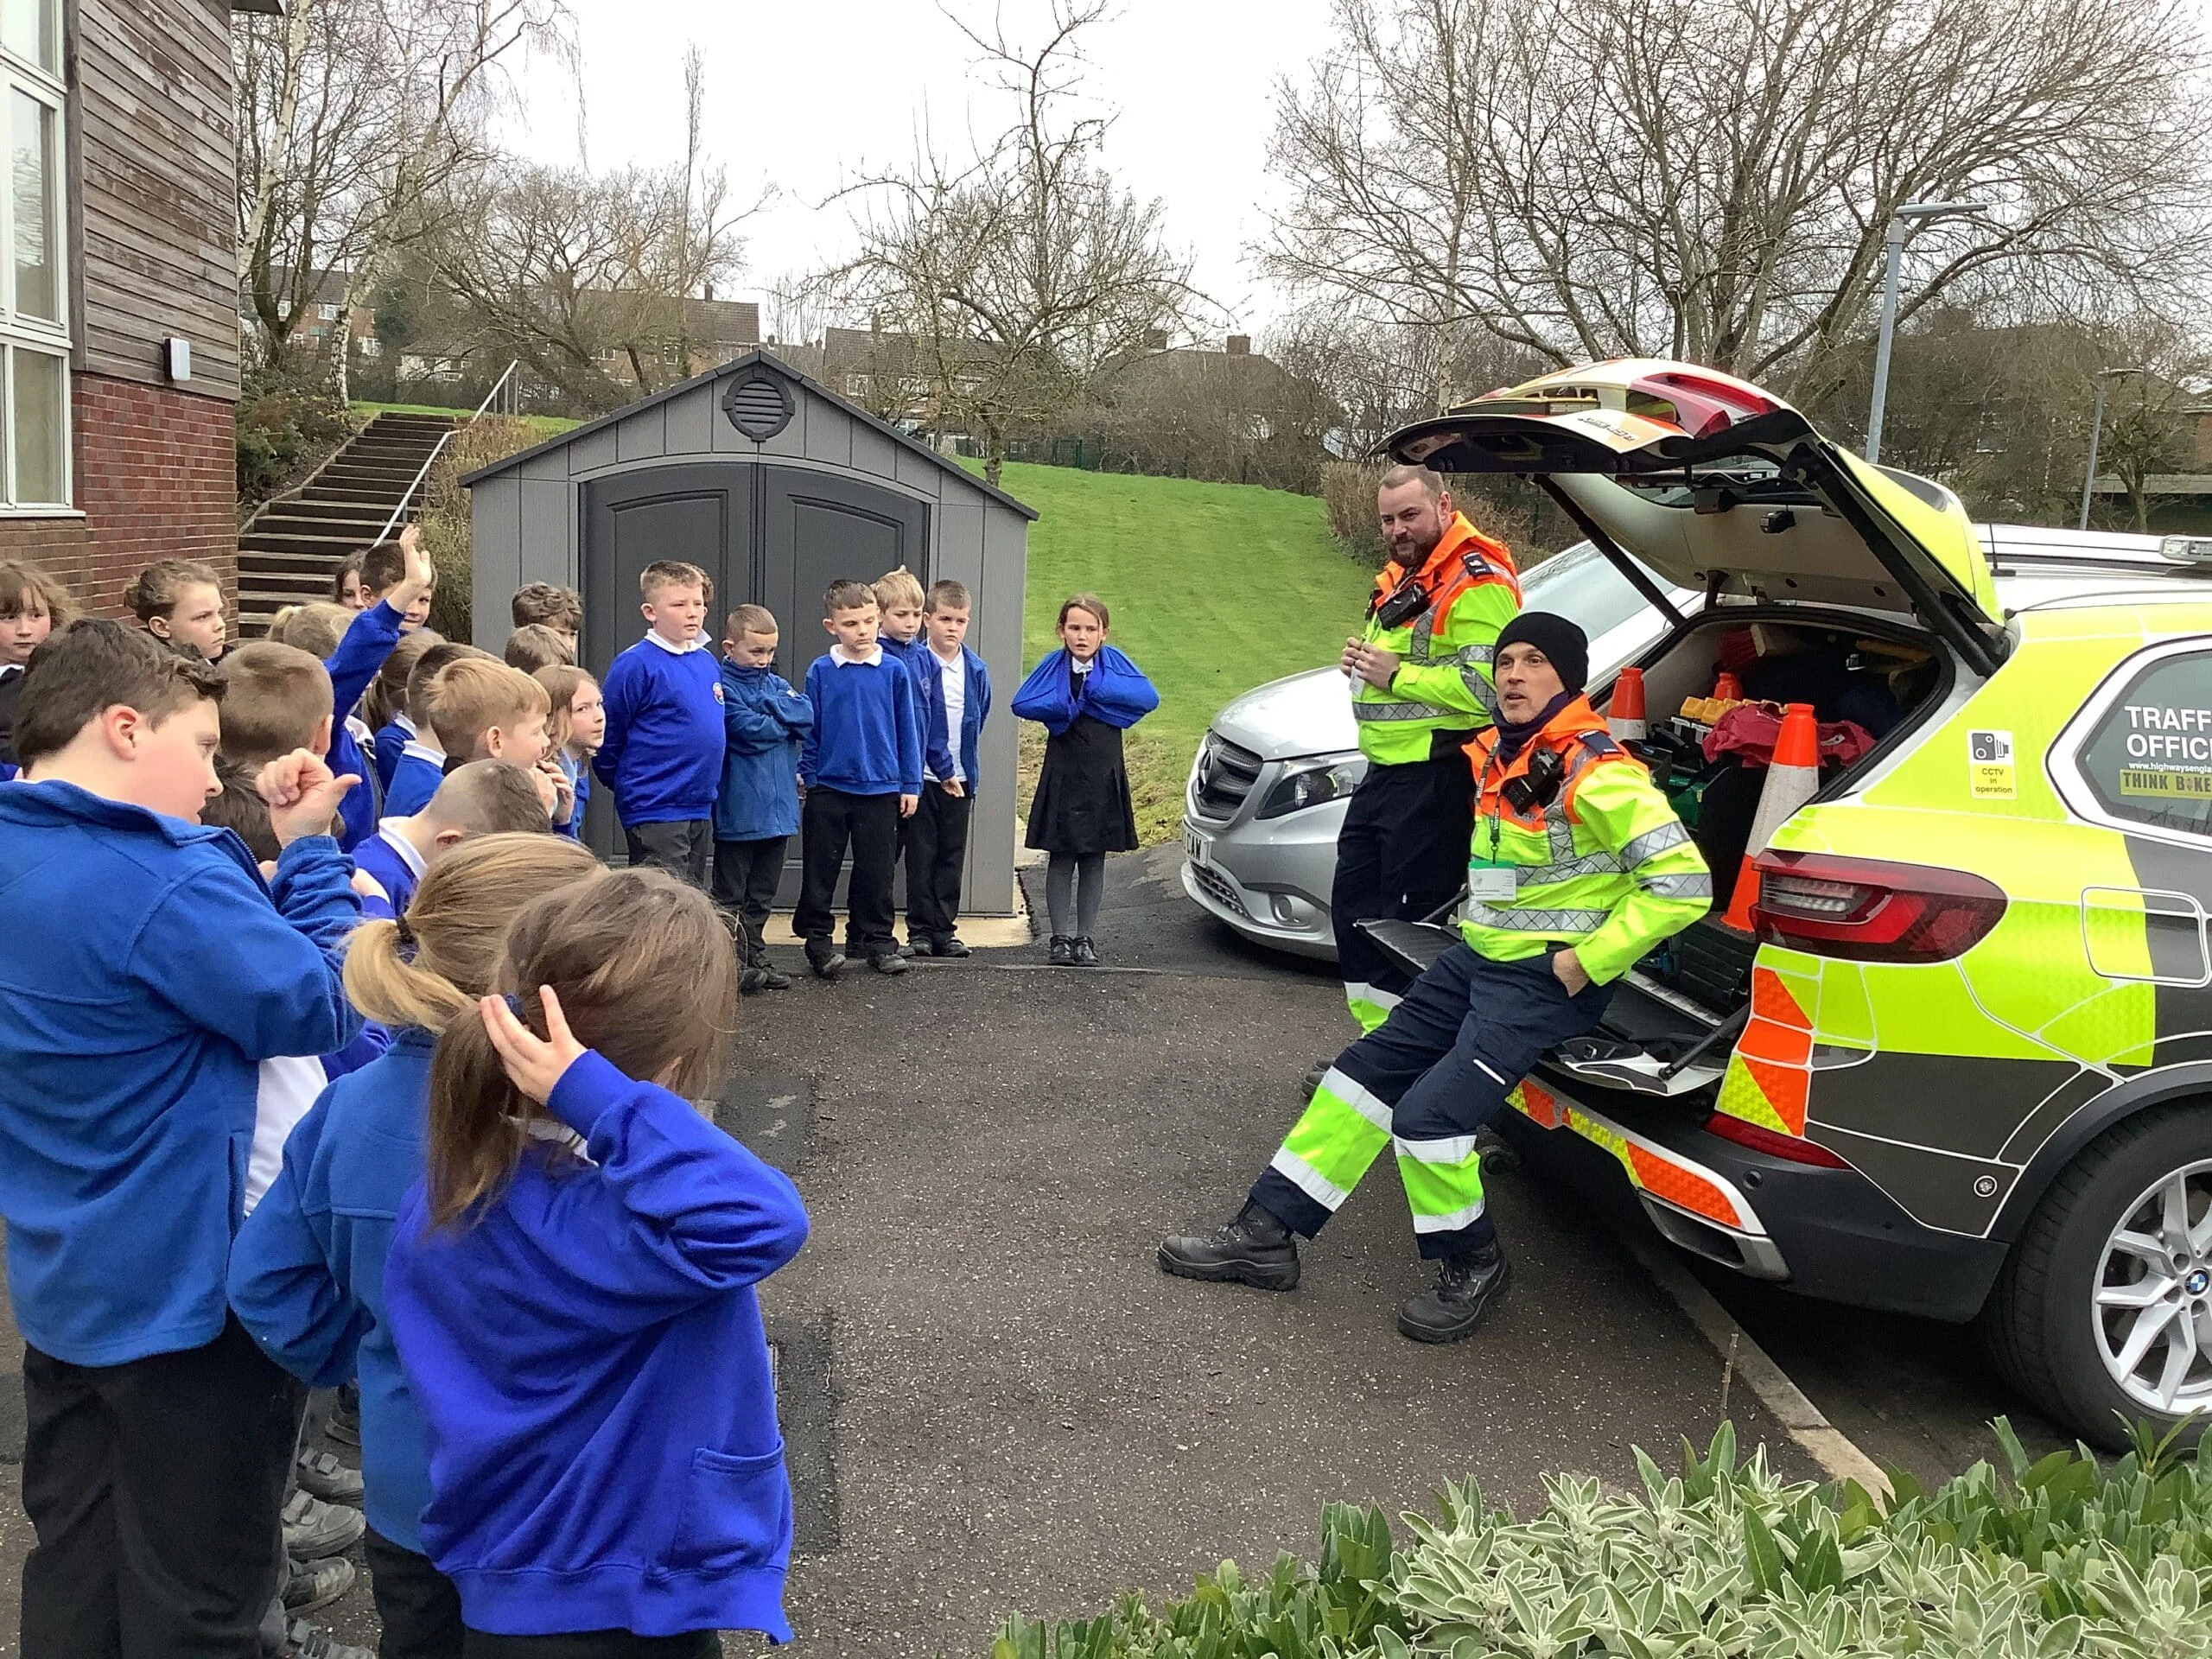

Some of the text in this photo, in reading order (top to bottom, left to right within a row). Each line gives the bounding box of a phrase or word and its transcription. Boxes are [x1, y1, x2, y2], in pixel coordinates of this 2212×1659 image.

[2126, 734, 2212, 760] OFFIC
[1981, 767, 2004, 776] CCTV
[2123, 772, 2168, 790] THINK
